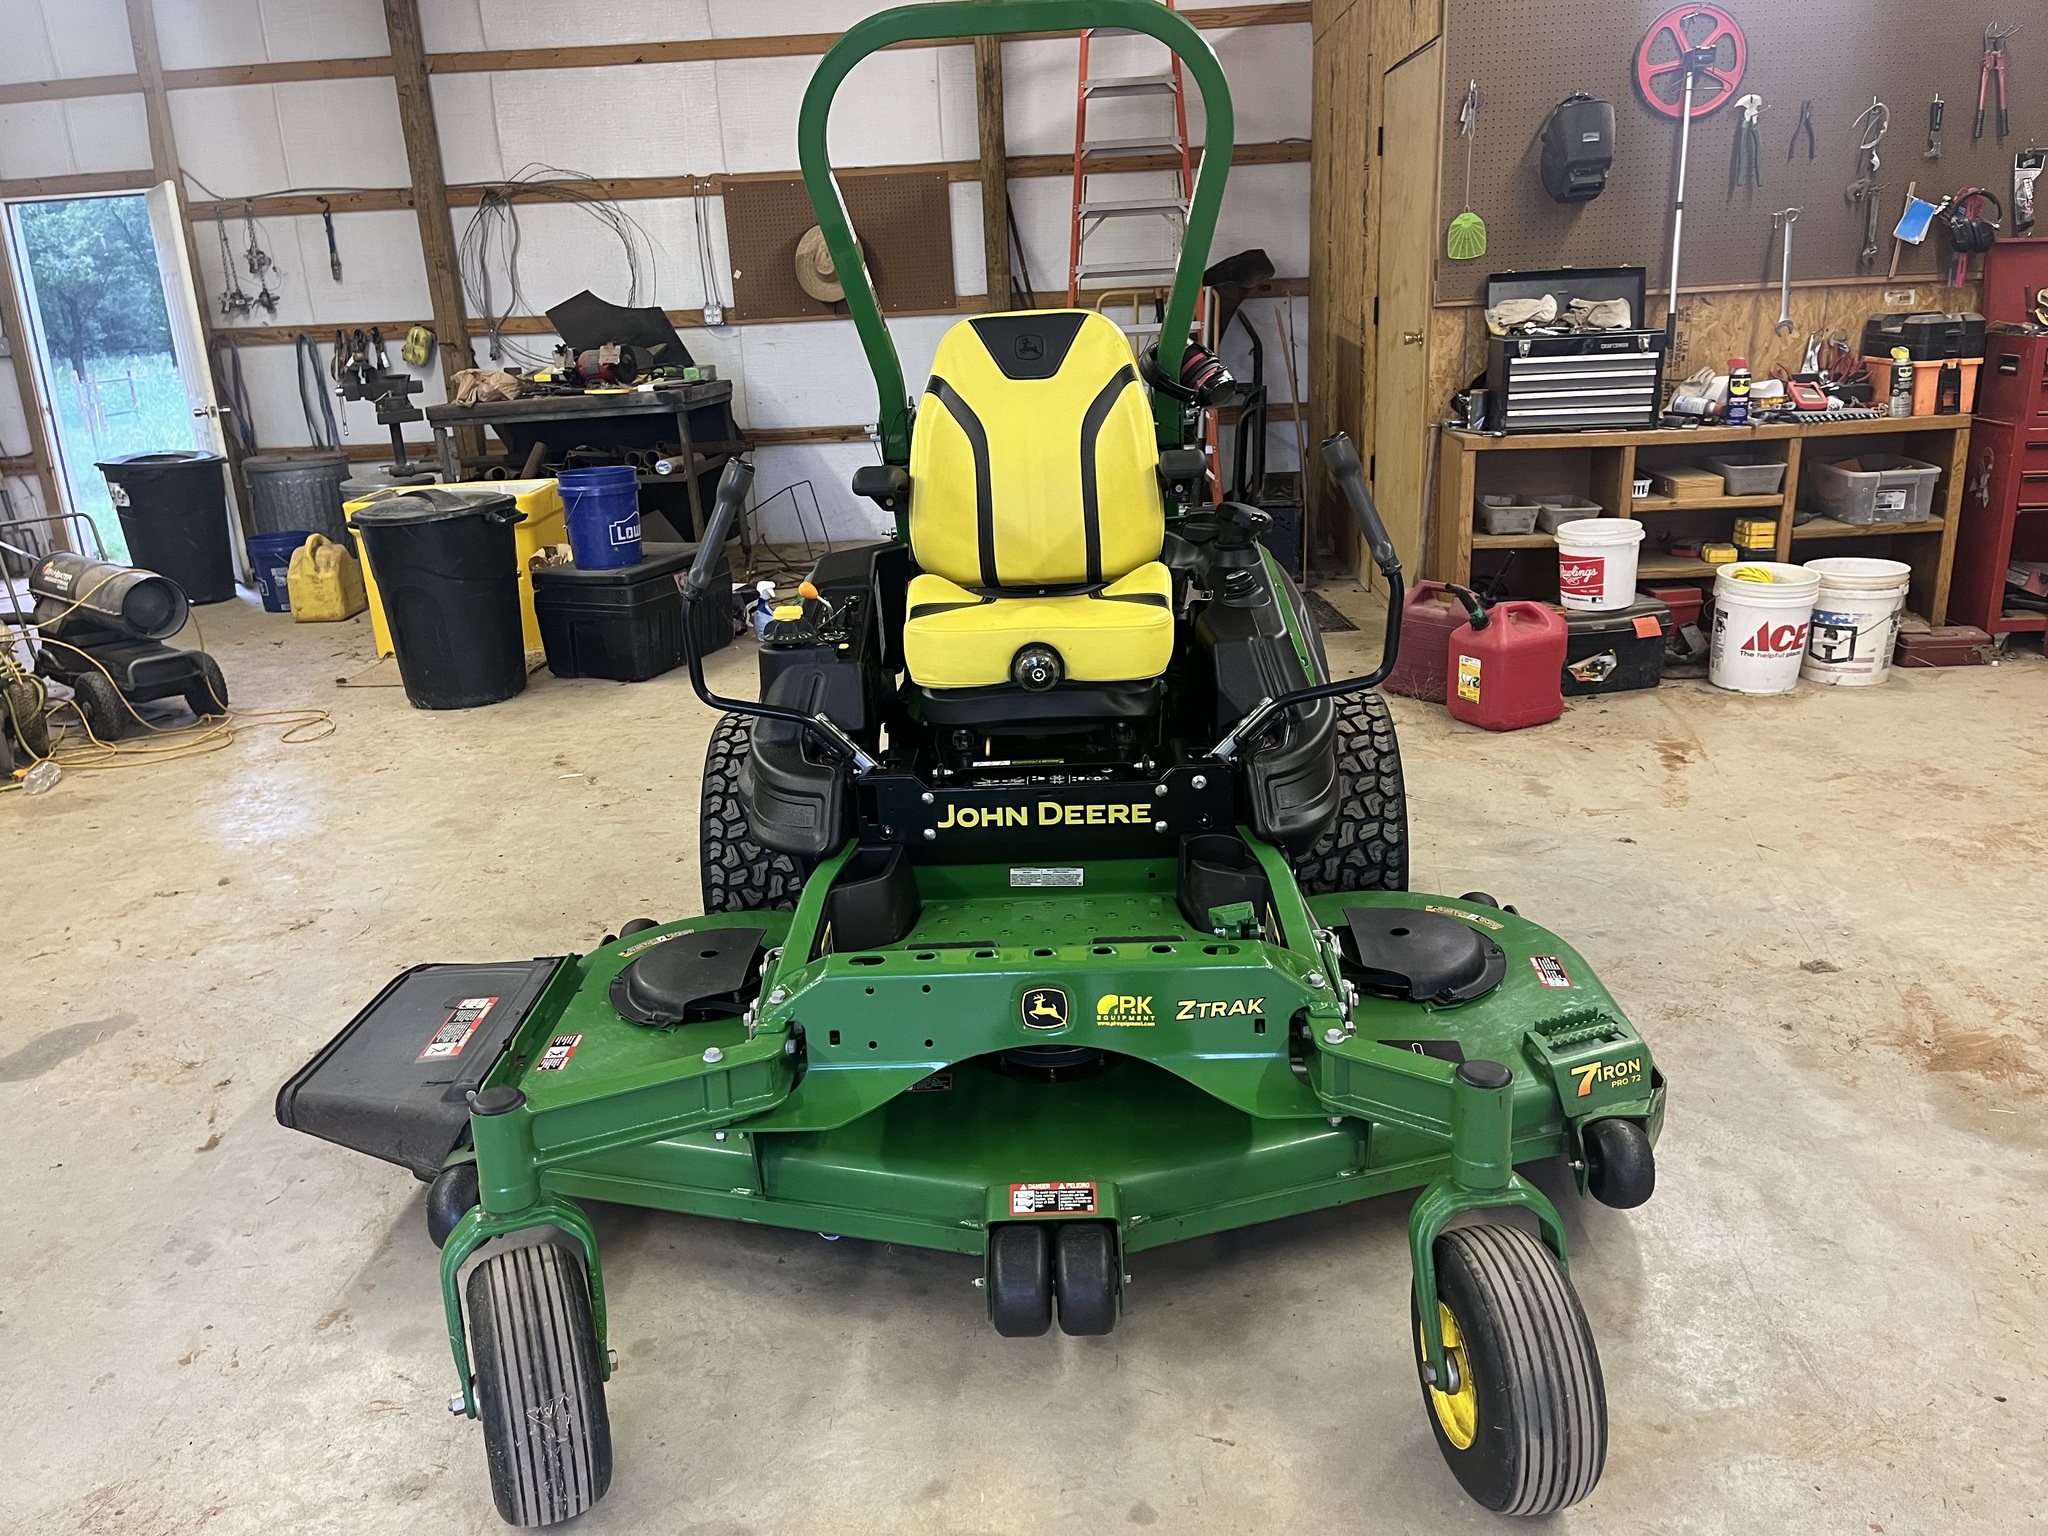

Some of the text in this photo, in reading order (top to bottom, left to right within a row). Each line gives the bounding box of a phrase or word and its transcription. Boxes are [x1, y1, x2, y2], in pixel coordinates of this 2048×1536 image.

[1741, 621, 1808, 652] ACE
[938, 802, 1151, 828] JOHN DEERE
[1176, 998, 1263, 1020] ZTRAK
[1611, 1075, 1642, 1088] PRO 72
